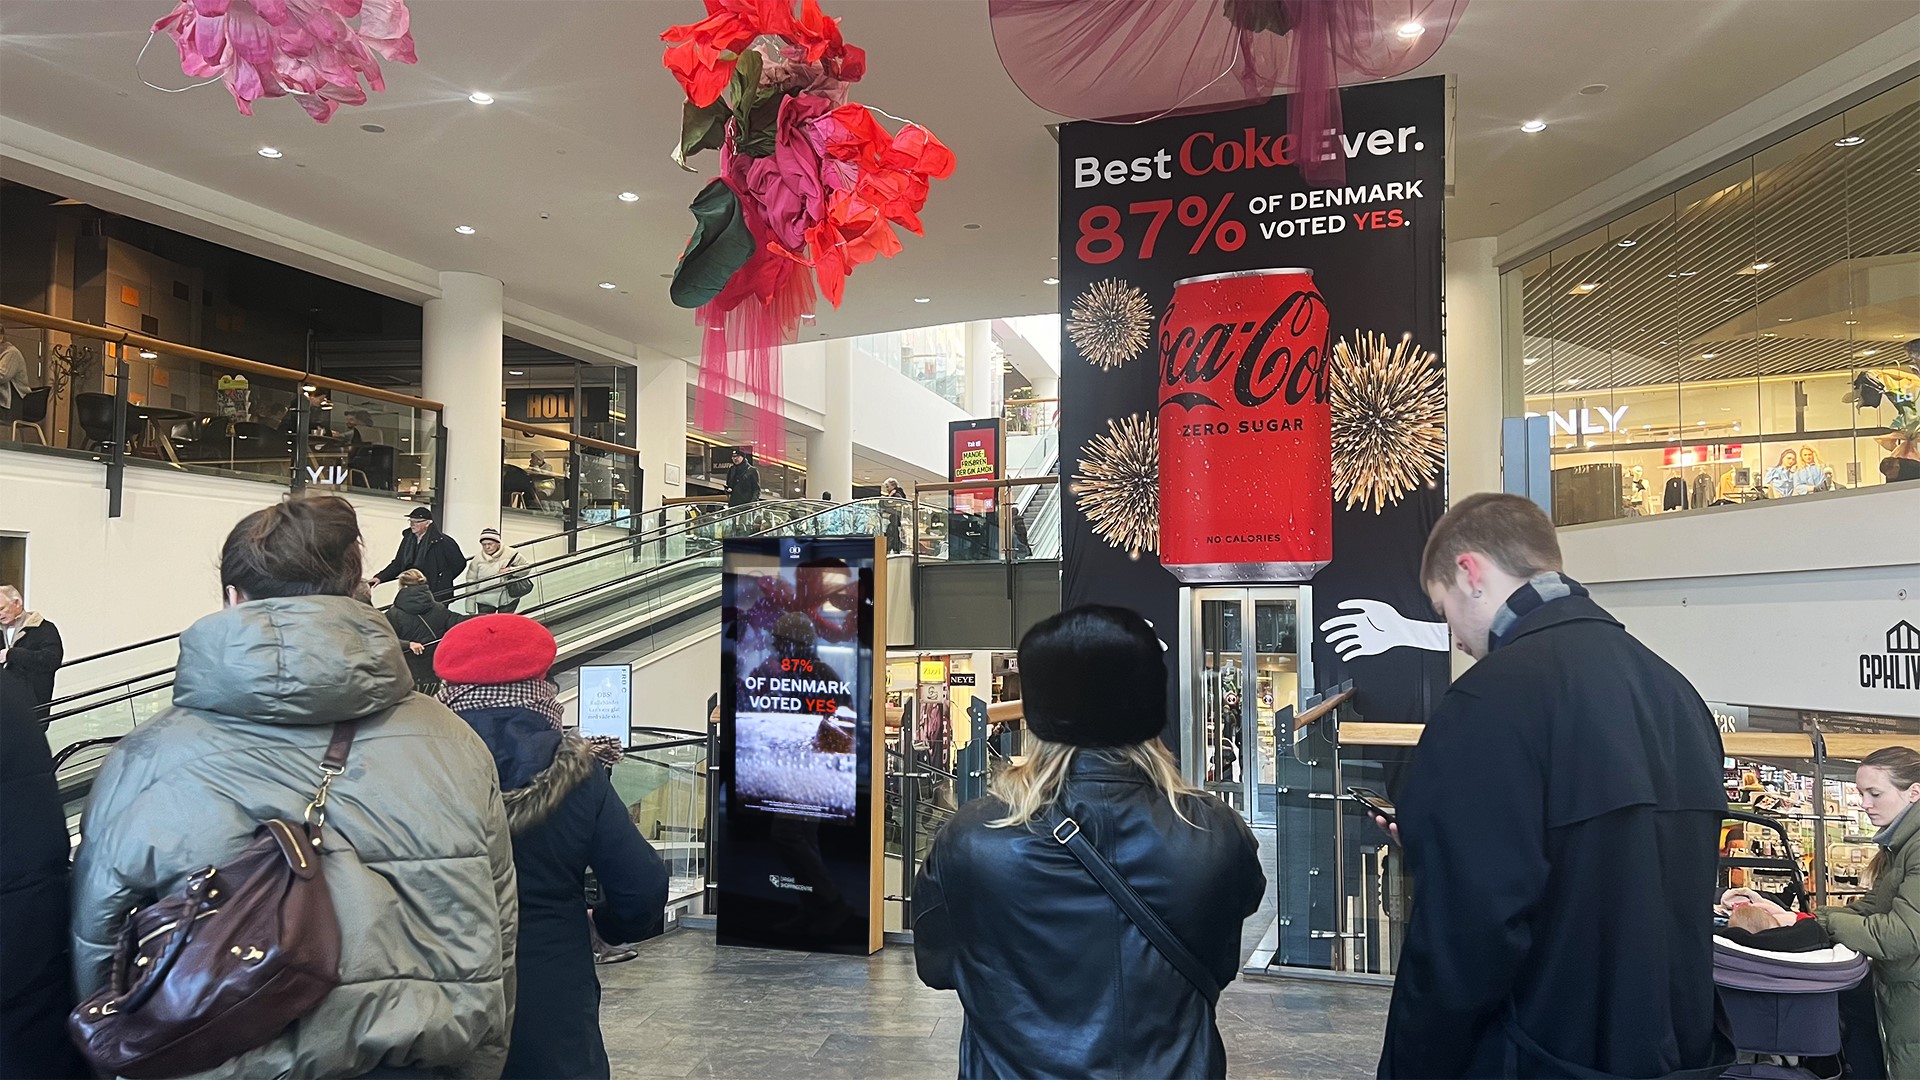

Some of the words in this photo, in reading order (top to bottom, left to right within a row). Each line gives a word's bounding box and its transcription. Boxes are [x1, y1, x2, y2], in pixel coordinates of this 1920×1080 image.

[1074, 148, 1172, 188] Best
[1179, 127, 1297, 176] Coke
[1318, 125, 1425, 164] Ever.
[1249, 194, 1283, 215] OF
[1290, 179, 1424, 211] DENMARK
[1075, 191, 1247, 265] 87%
[1259, 215, 1346, 240] VOTED
[1354, 208, 1411, 232] YES.
[1182, 422, 1229, 437] ZERO
[1238, 417, 1304, 433] SUGAR
[1525, 405, 1629, 437] NLY
[1206, 535, 1222, 544] NO
[1224, 533, 1281, 543] CALORIES
[781, 658, 813, 673] 87%
[745, 676, 767, 691] OF
[770, 677, 851, 695] DENMARK
[950, 676, 975, 684] NEYE
[749, 695, 802, 711] VOTED
[805, 698, 837, 713] YES
